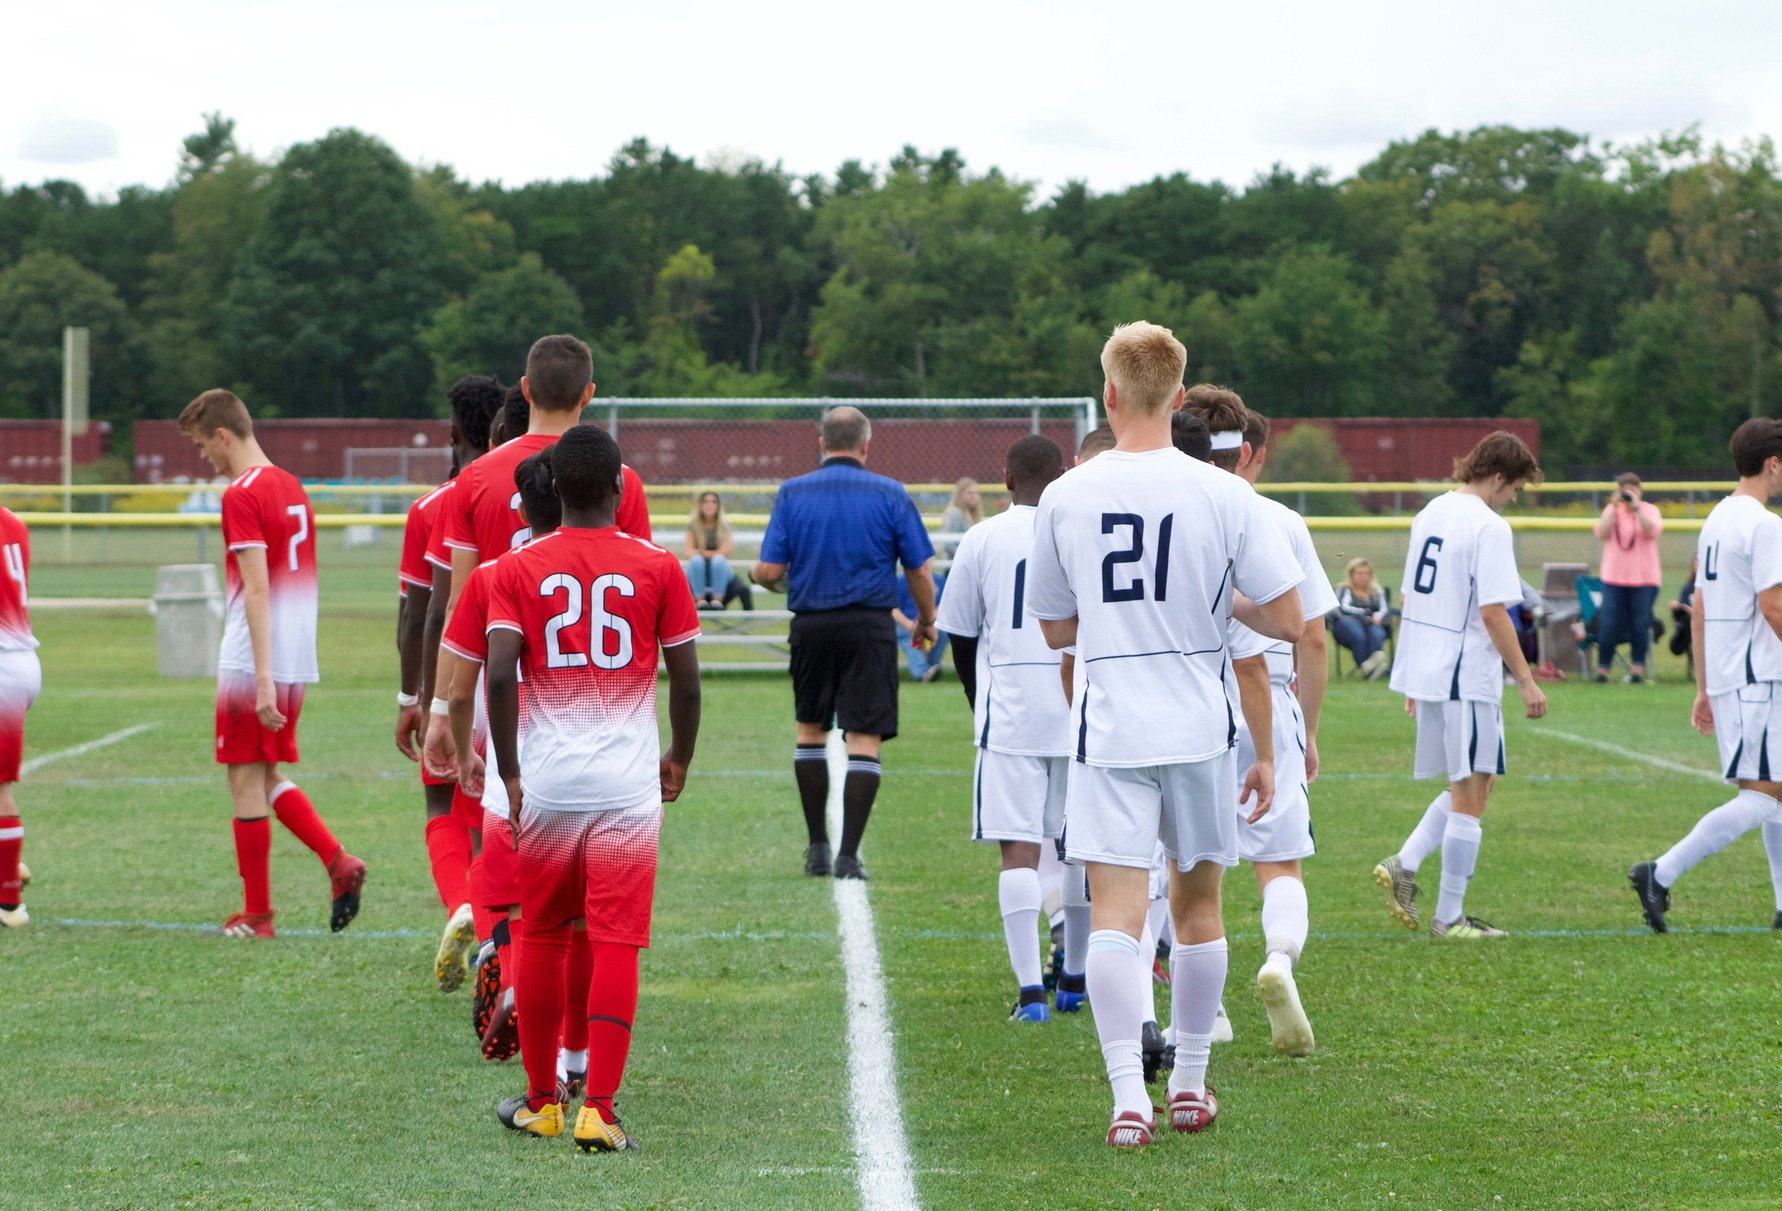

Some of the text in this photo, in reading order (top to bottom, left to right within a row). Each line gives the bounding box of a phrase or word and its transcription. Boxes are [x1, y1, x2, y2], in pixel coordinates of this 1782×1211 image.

[287, 503, 309, 573] 7
[1101, 512, 1174, 603] 21
[1414, 535, 1445, 595] 6
[3, 542, 29, 607] 4
[1012, 557, 1027, 629] 1
[538, 571, 636, 671] 26
[1113, 1127, 1143, 1145] NIKE
[1172, 1109, 1200, 1127] NIKE
